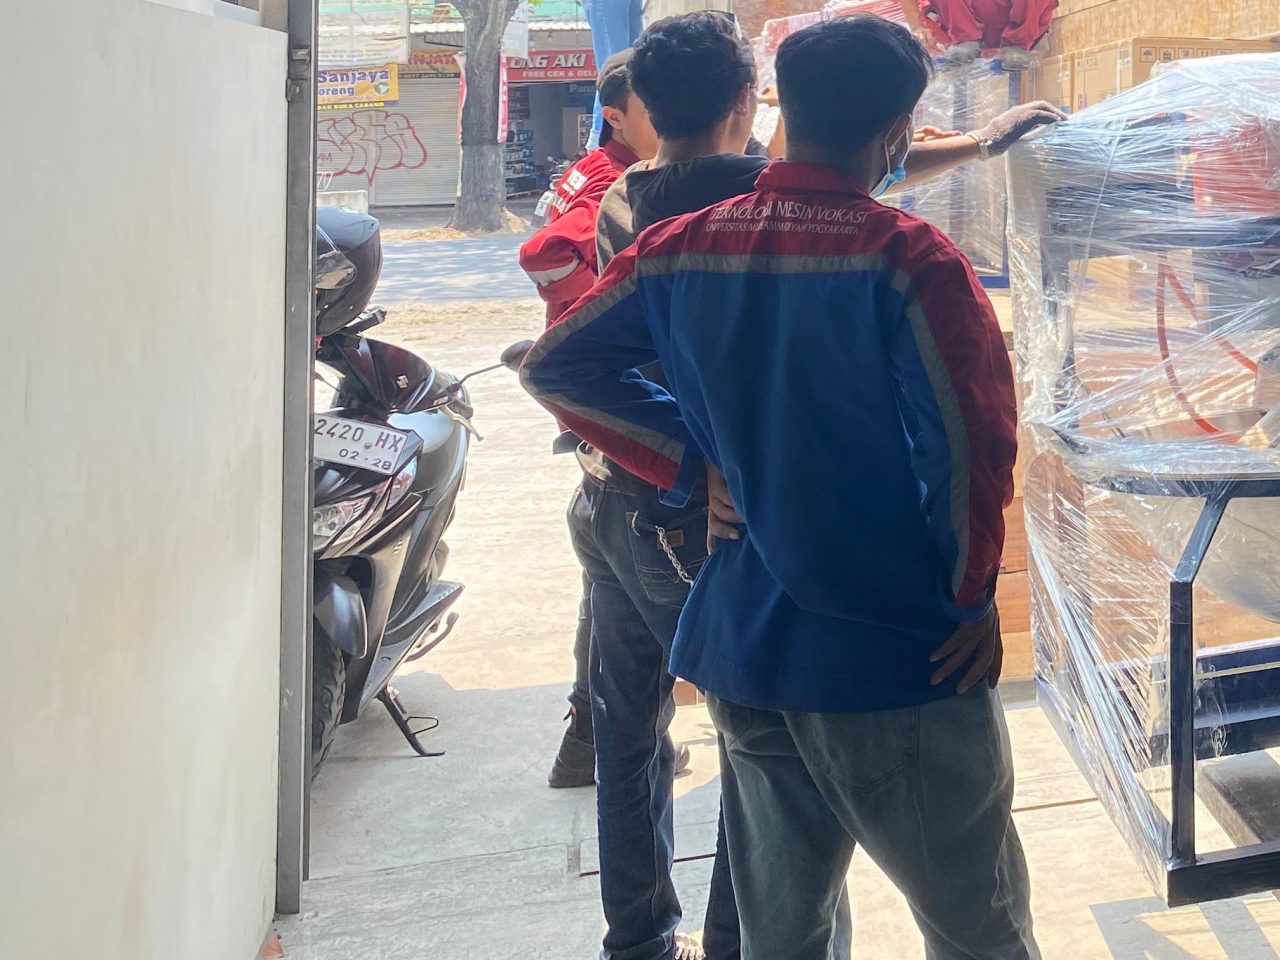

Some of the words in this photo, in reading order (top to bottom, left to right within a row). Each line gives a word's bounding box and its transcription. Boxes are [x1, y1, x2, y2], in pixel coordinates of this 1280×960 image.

[553, 53, 586, 67] AKI
[318, 70, 389, 84] Sanjaya
[776, 201, 815, 219] MESIN
[816, 206, 868, 224] VOKASI
[706, 222, 747, 232] UNIVERSITAS
[805, 224, 859, 236] YOGYAKARTA
[315, 419, 365, 442] 2420
[375, 431, 403, 453] HX
